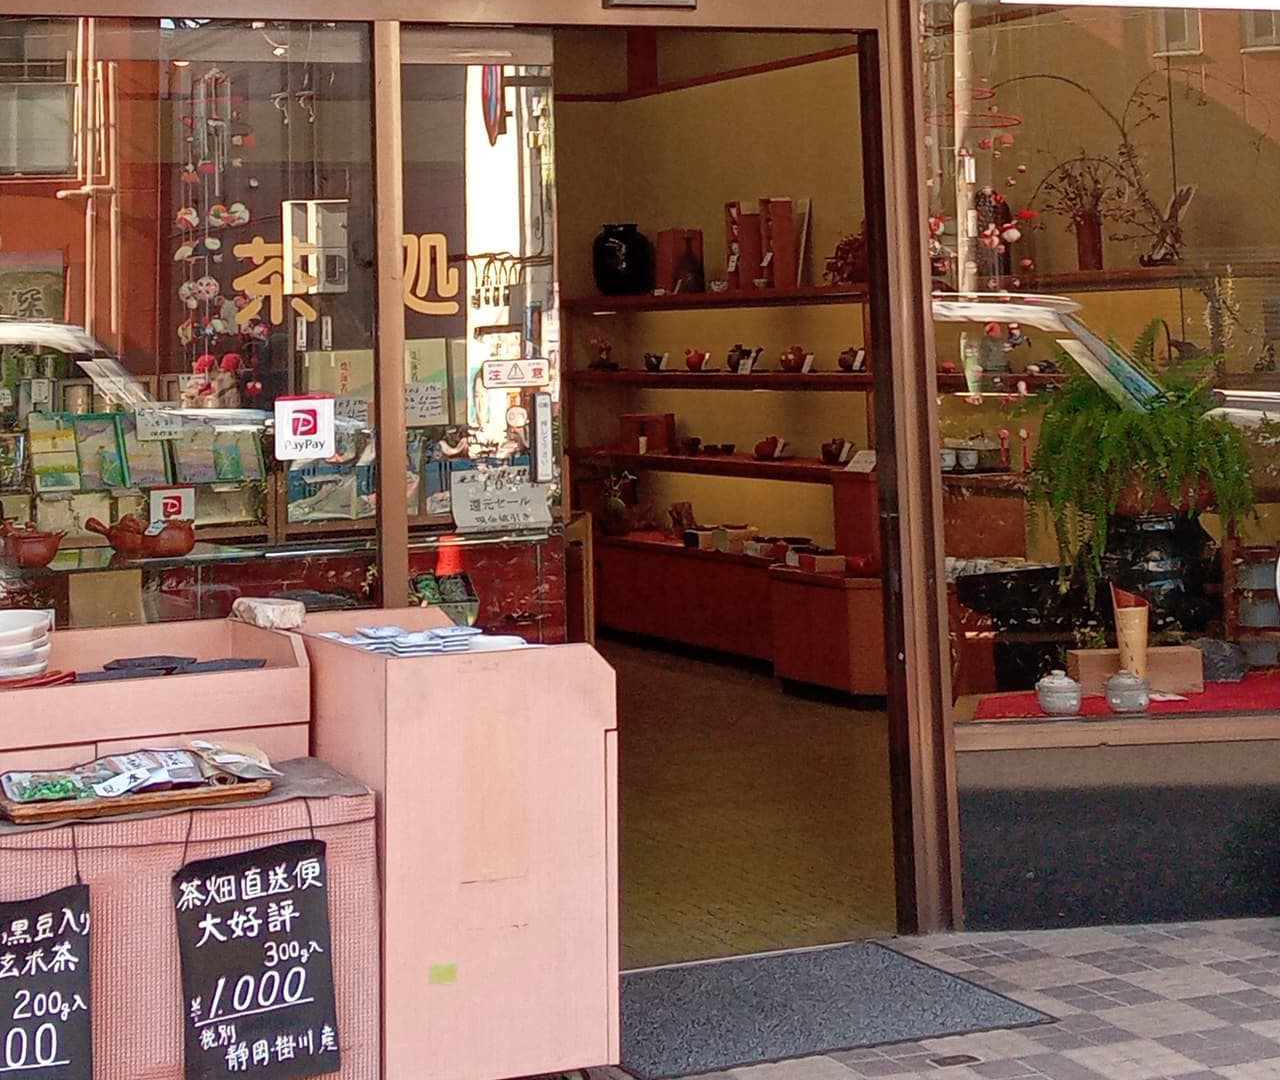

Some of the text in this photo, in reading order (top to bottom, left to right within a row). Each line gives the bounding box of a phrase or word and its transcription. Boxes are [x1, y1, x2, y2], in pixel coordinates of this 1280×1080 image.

[285, 439, 326, 452] PayPay
[176, 858, 323, 912] 茶畑直送便
[195, 899, 300, 948] 大好評
